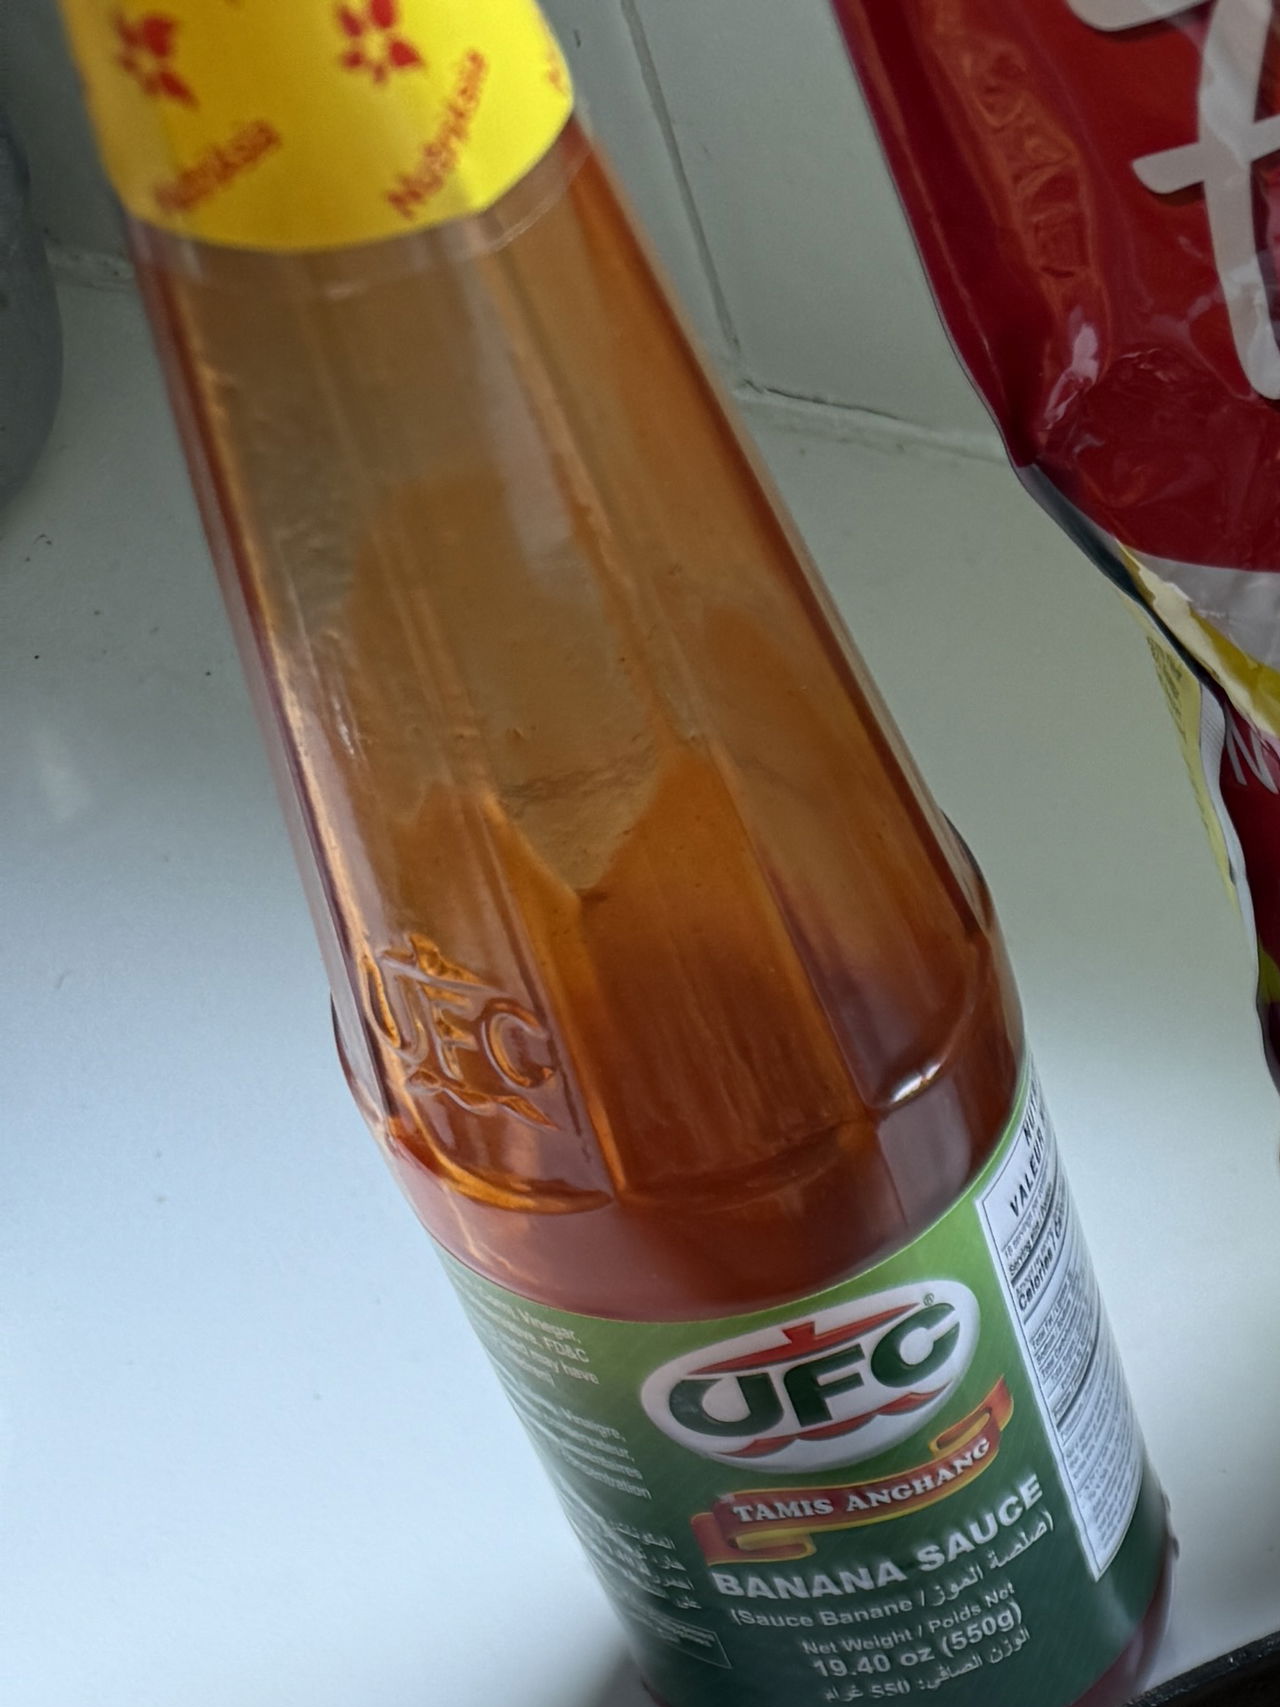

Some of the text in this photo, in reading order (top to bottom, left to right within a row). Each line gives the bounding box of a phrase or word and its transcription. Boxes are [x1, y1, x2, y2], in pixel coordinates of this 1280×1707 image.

[669, 1302, 961, 1438] UFC
[733, 1438, 990, 1523] TAMIS ANGHANG
[711, 1473, 1043, 1600] BANANA SAUCE
[802, 1641, 838, 1656] Net
[842, 1630, 914, 1653] Weight
[813, 1600, 1023, 1679] 19.40 oz (550g)
[820, 1599, 913, 1627] Banane
